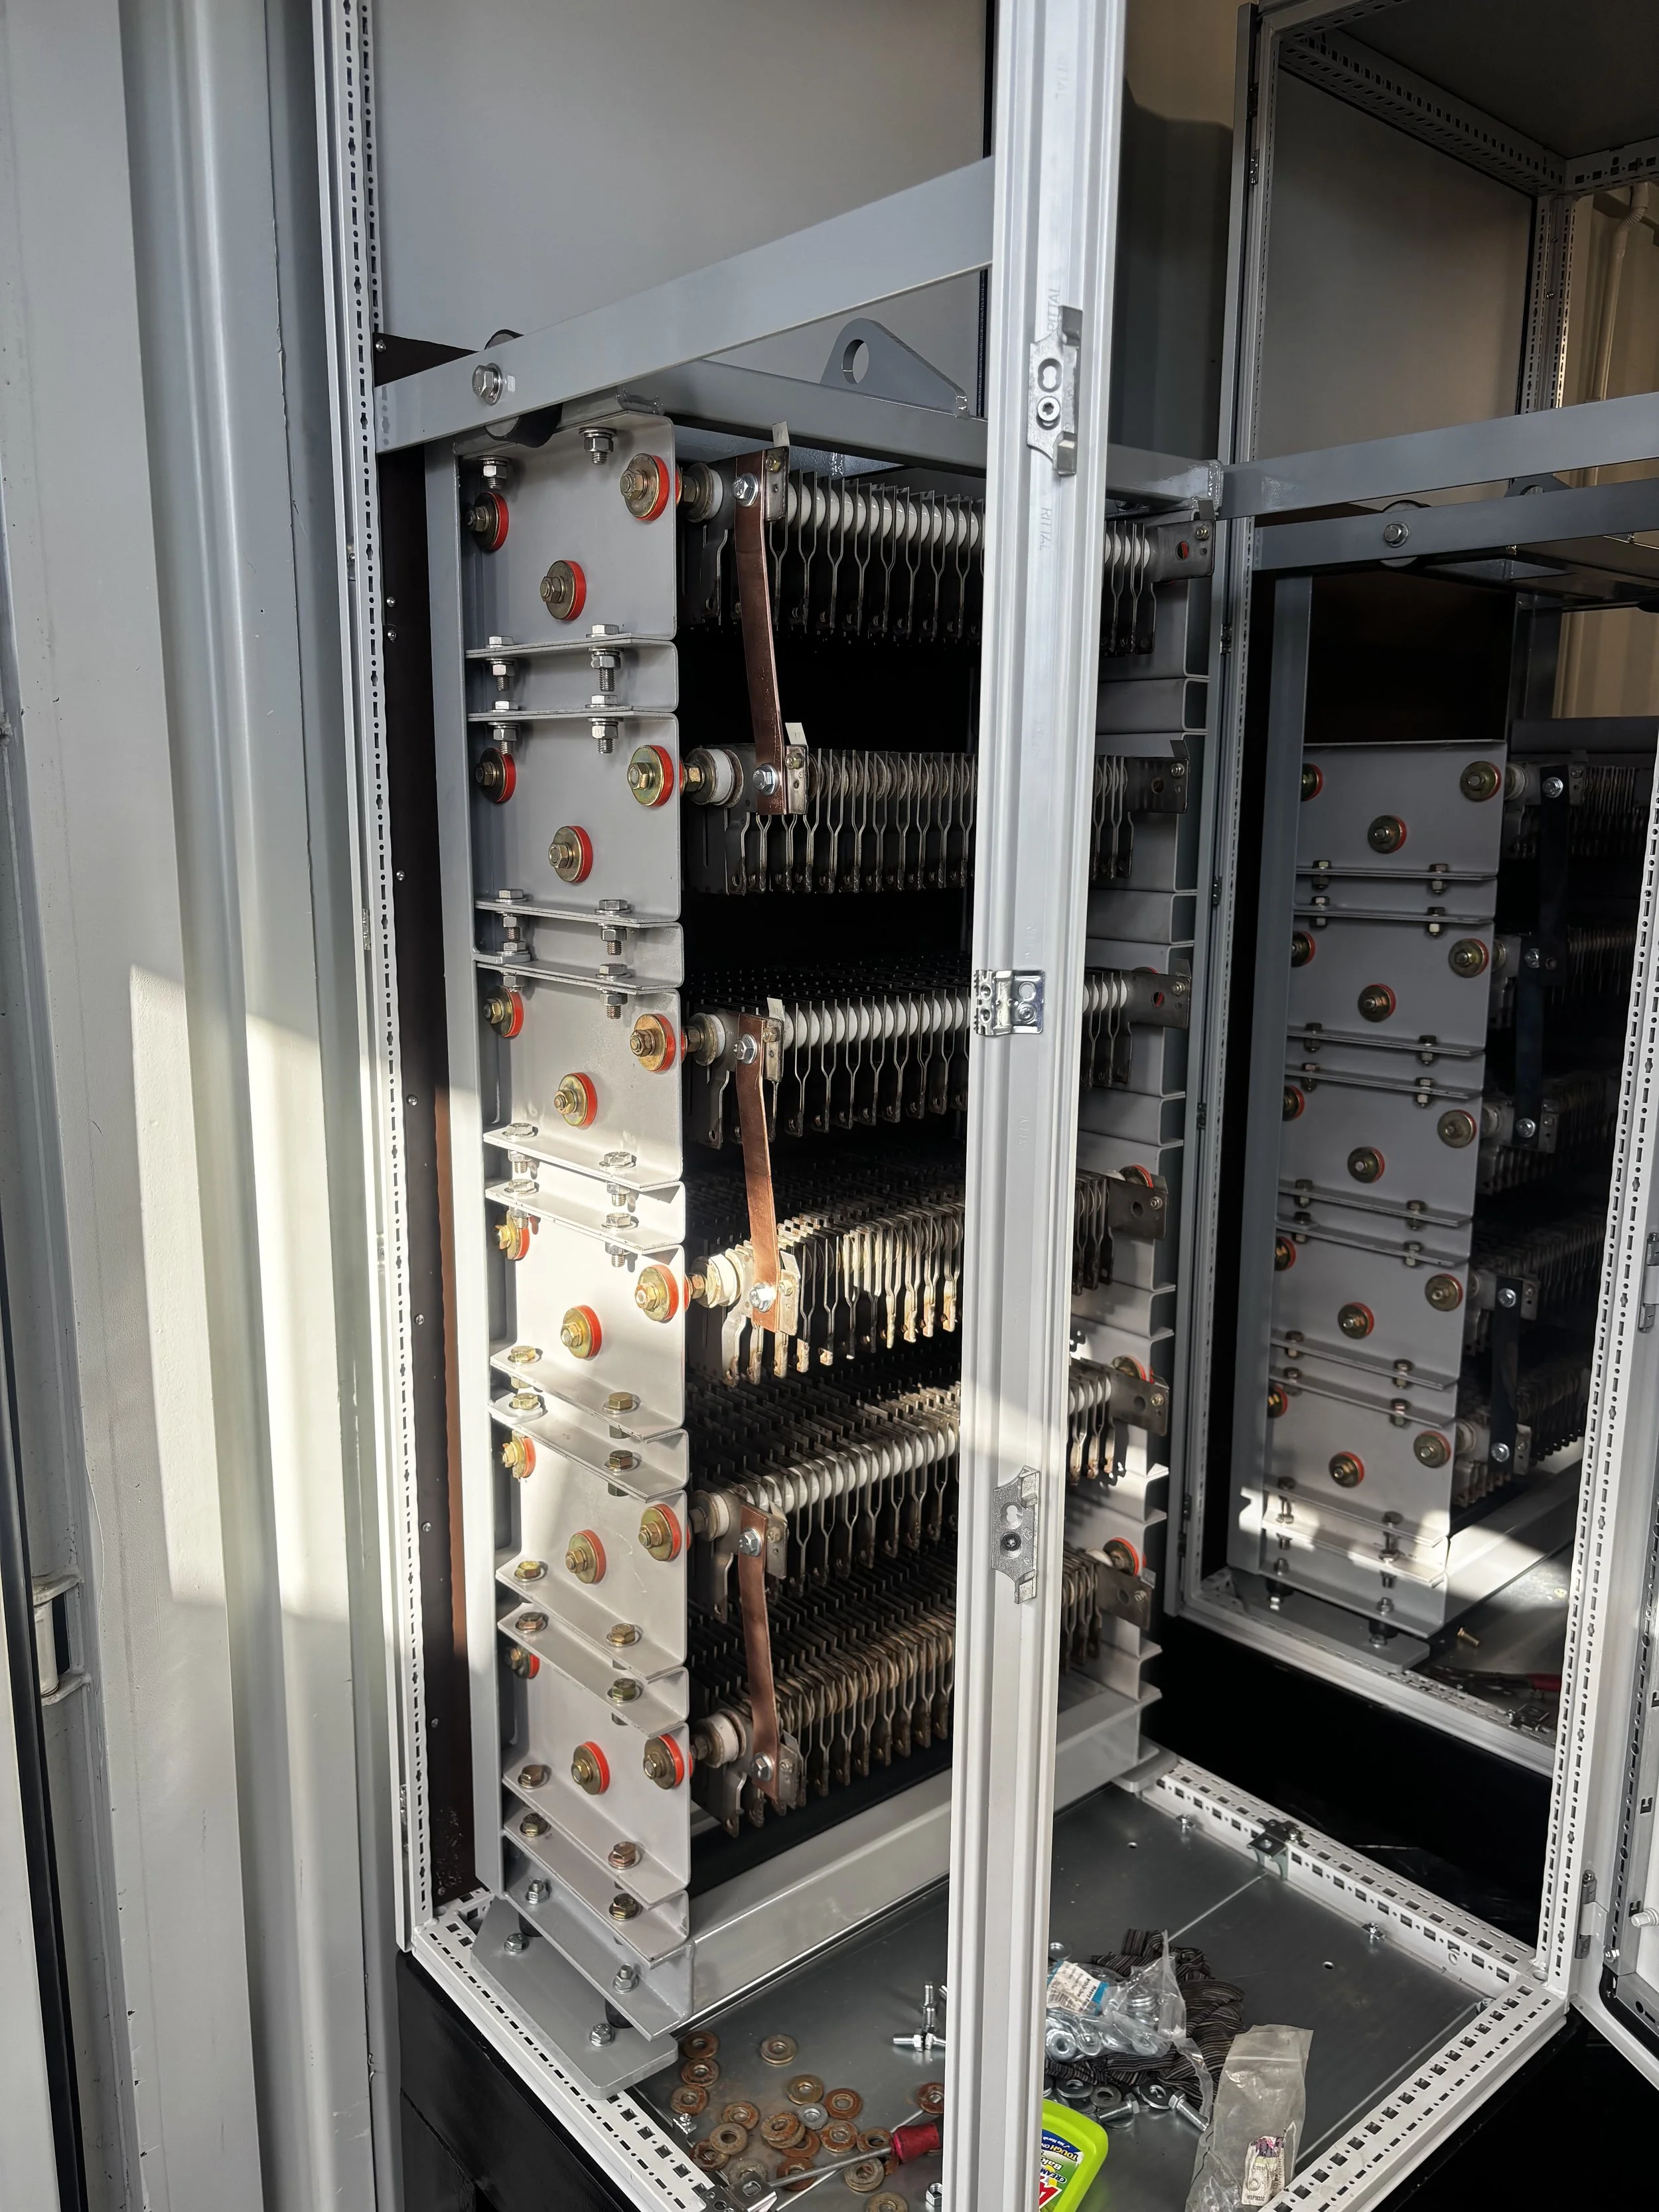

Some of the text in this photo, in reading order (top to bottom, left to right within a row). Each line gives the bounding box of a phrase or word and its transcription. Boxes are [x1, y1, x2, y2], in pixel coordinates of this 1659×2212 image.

[1040, 507, 1052, 551] RITTAL
[1050, 2145, 1078, 2162] TOUGH
[1041, 2168, 1066, 2183] CREAM
